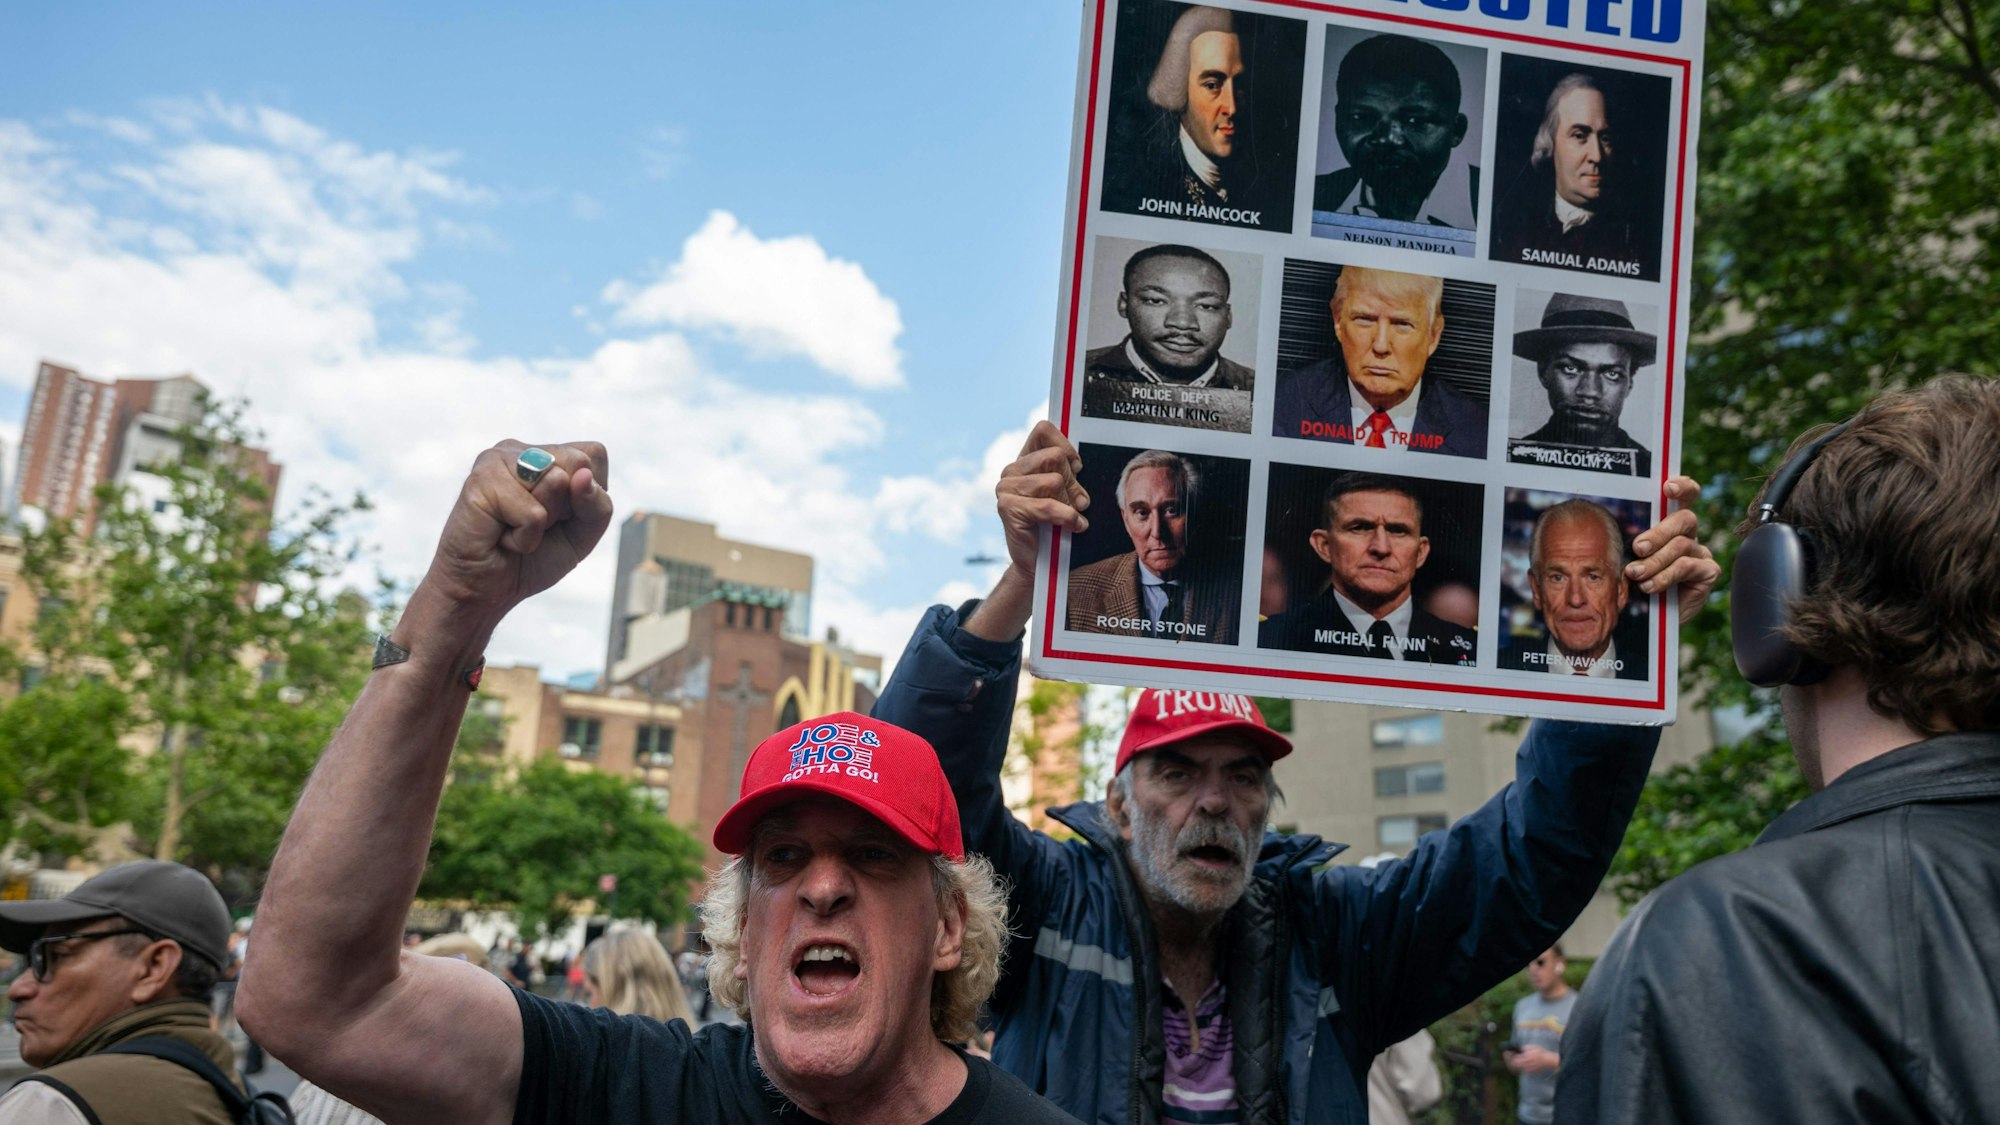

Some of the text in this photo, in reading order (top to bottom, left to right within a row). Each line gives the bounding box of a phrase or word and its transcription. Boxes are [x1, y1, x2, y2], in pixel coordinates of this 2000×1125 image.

[1138, 197, 1261, 225] JOHN HANCOCK
[1343, 232, 1456, 255] NELSON MANDELA
[1521, 247, 1640, 276] SAMUAL ADAMS
[1131, 386, 1212, 404] POLICE DEPT
[1185, 408, 1220, 424] KING
[1300, 420, 1444, 449] DONALD TRUMP
[1535, 448, 1601, 469] MALCOLM
[1602, 456, 1613, 470] X
[1096, 615, 1206, 636] ROGER STONE
[1314, 629, 1426, 652] MICHEAL FLYNN
[1522, 651, 1562, 666] PETER
[1152, 688, 1254, 722] TRUMP
[788, 723, 881, 752] JOE &
[790, 749, 803, 771] THE
[800, 744, 872, 769] HOE
[781, 763, 879, 784] GOTTA GO!
